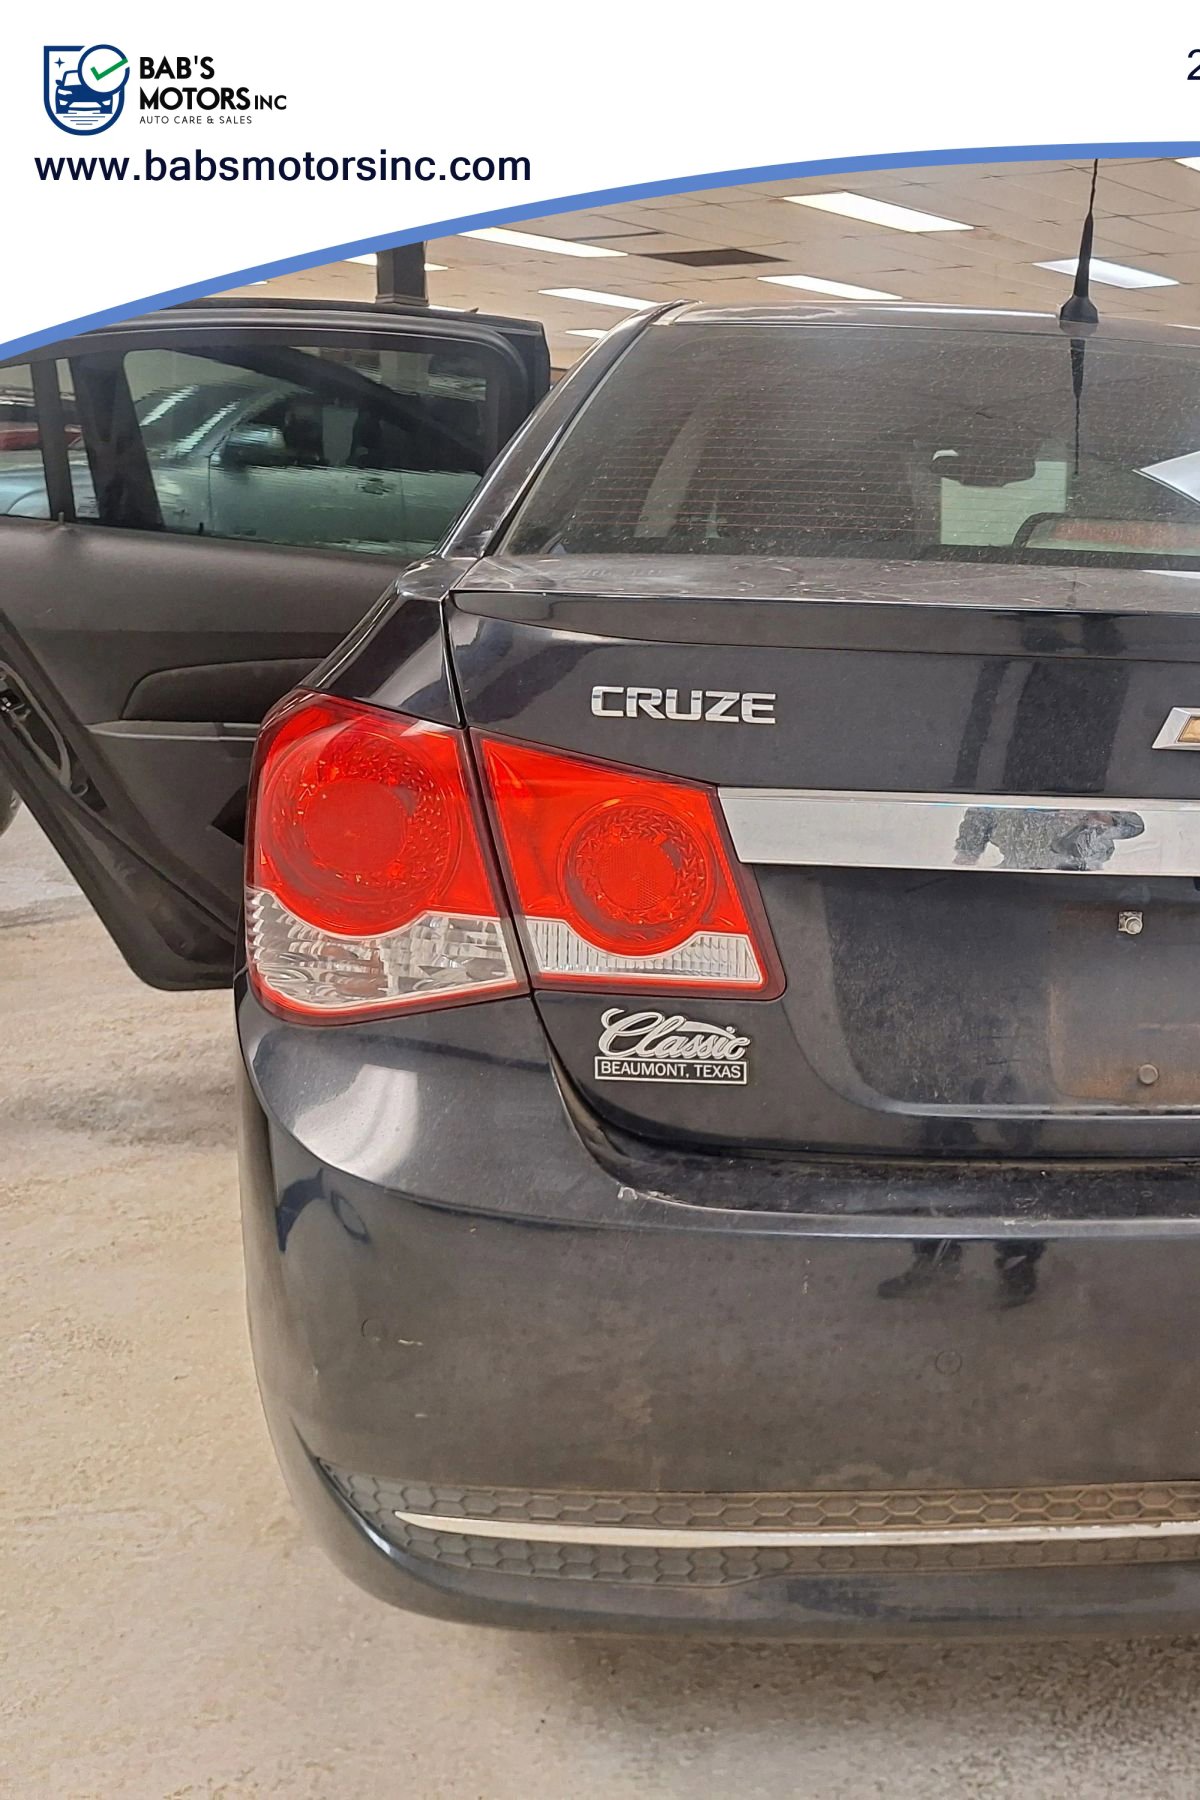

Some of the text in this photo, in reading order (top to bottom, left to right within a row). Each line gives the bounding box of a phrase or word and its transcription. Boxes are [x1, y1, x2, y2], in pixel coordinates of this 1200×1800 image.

[591, 685, 776, 724] CRUZE
[599, 1007, 751, 1060] Classic
[601, 1061, 741, 1079] BEAUMONT, TEXAS
